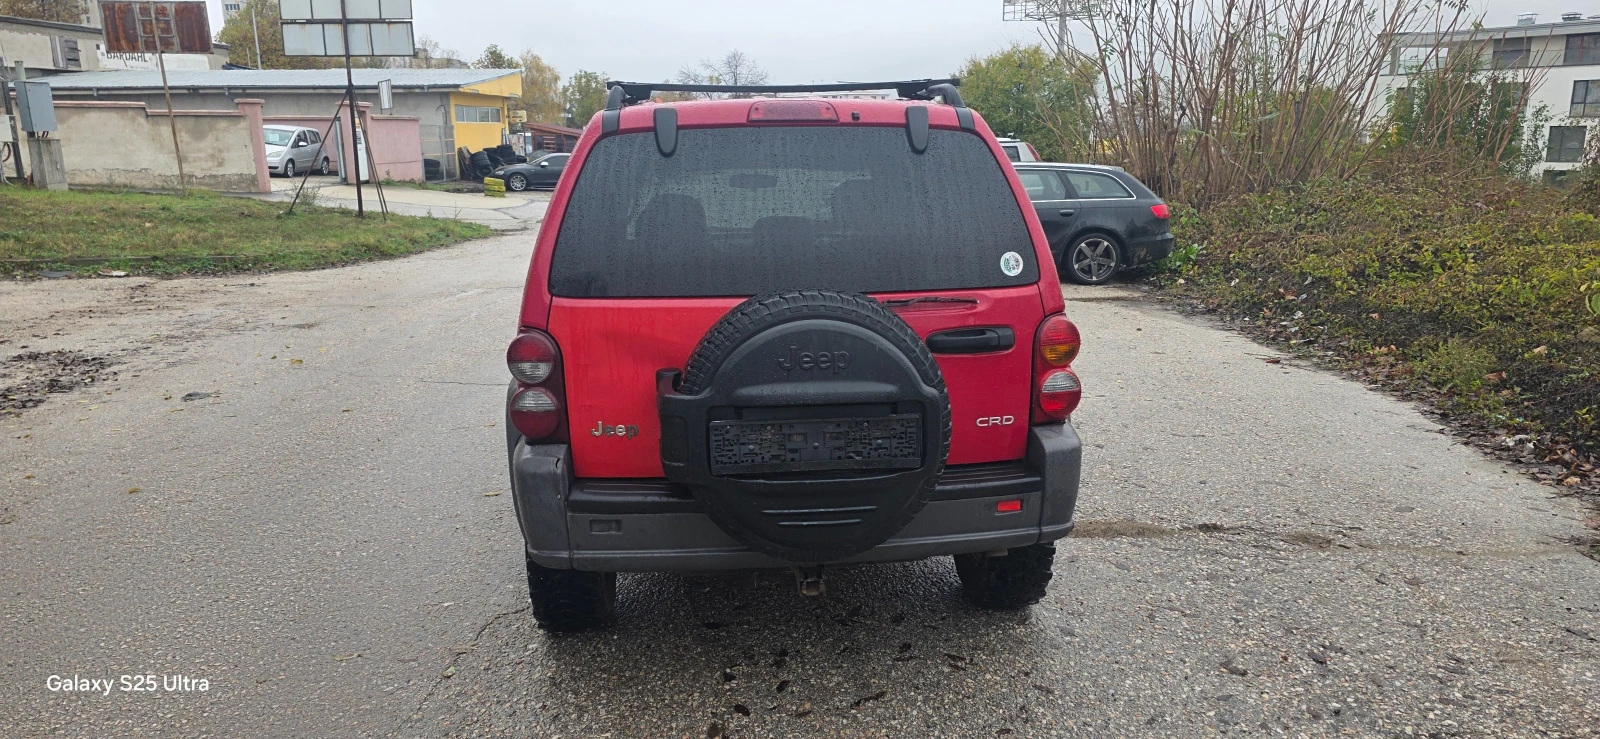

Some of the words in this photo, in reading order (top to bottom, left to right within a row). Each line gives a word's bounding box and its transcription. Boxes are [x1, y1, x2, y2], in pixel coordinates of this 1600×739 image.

[778, 345, 851, 375] Jeep
[591, 420, 639, 439] Jeep
[976, 415, 1015, 427] CRD
